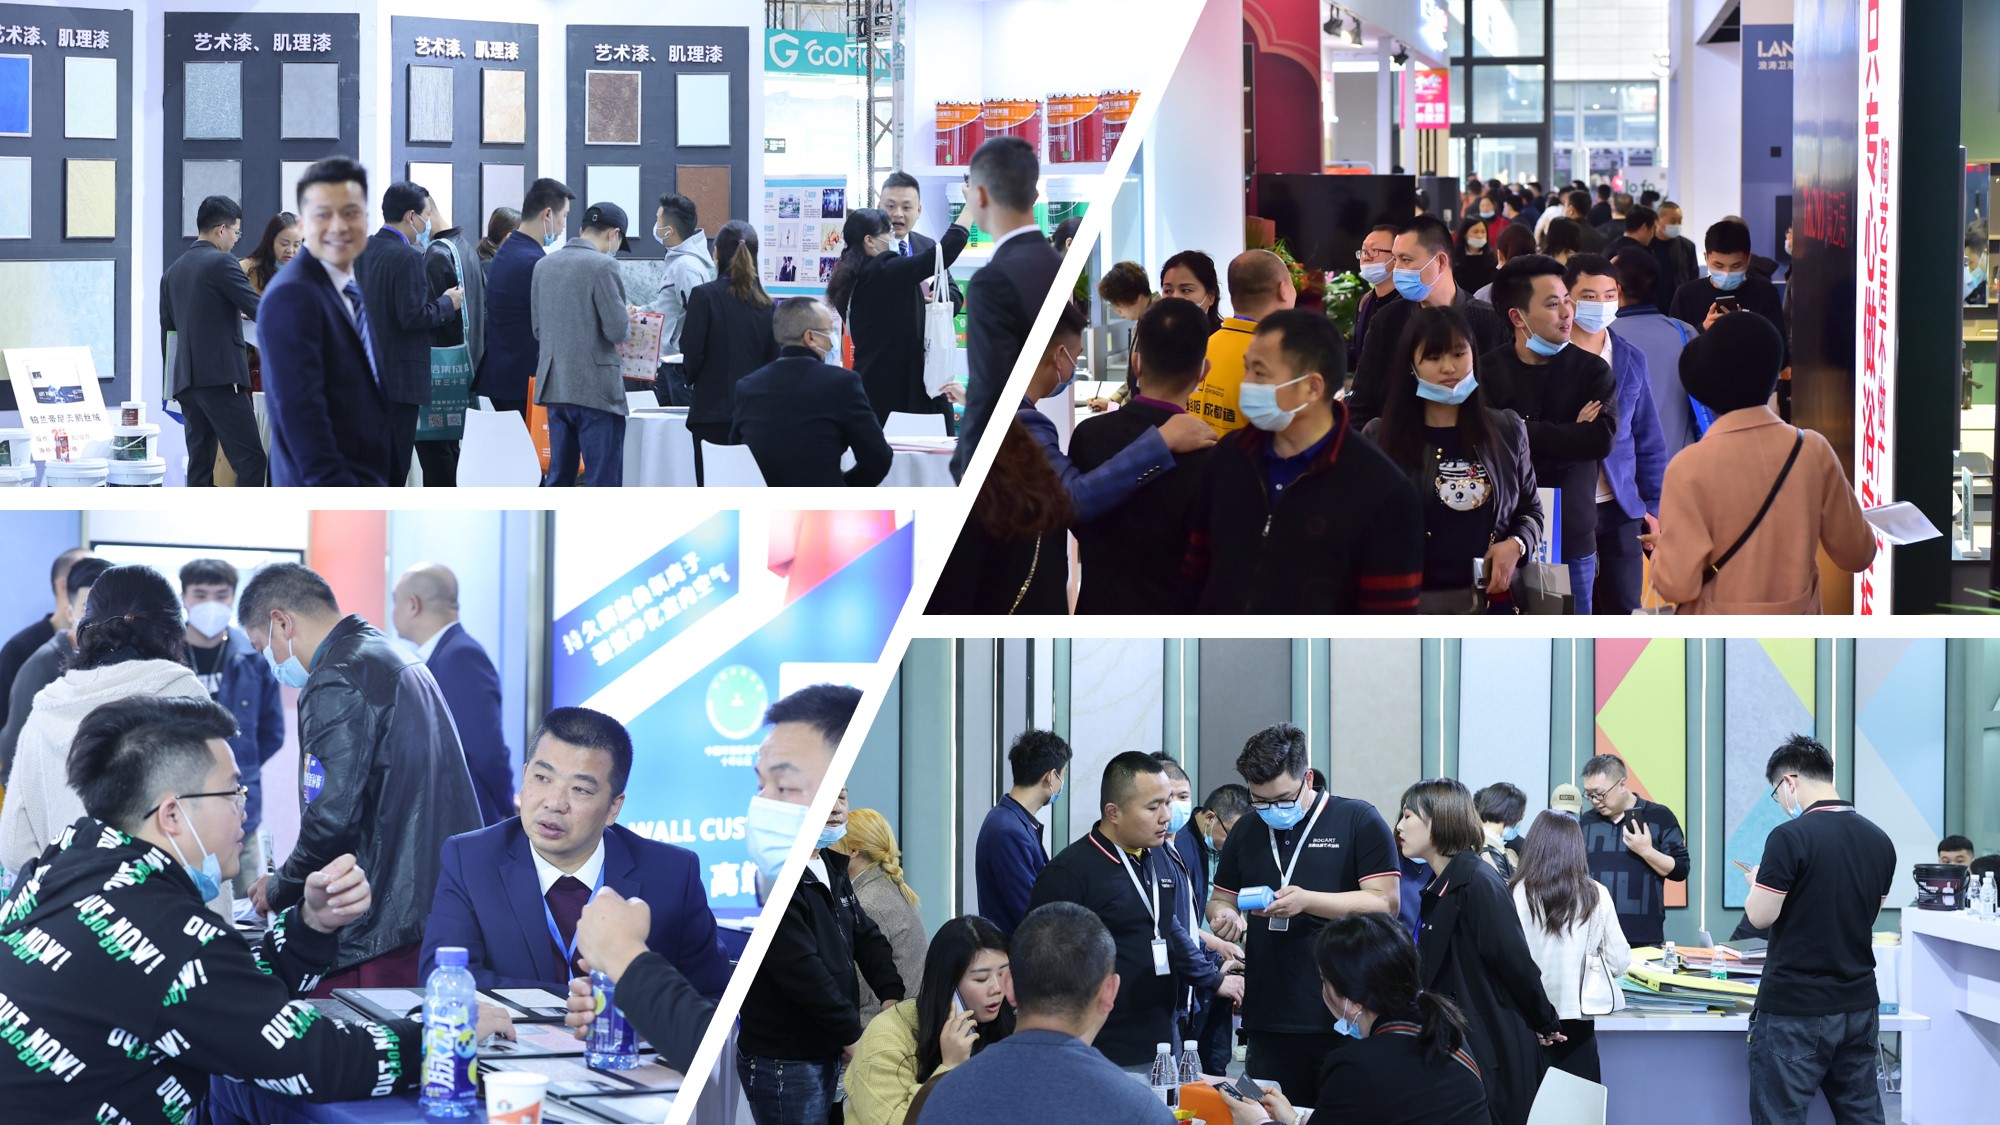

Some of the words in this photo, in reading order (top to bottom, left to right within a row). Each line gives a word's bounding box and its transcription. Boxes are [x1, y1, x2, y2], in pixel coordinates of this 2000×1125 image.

[0, 25, 110, 49] 术漆、肌理漆
[194, 32, 332, 53] 艺术漆、肌理漆
[414, 36, 520, 60] 艺术漆、肌理漆
[594, 44, 723, 63] 艺术漆、肌理漆
[1860, 0, 1880, 614] 只专心做浴
[1204, 403, 1236, 422] 成都造
[699, 816, 748, 842] CUS
[105, 916, 166, 975] NOW!
[22, 1026, 86, 1083] NOW!
